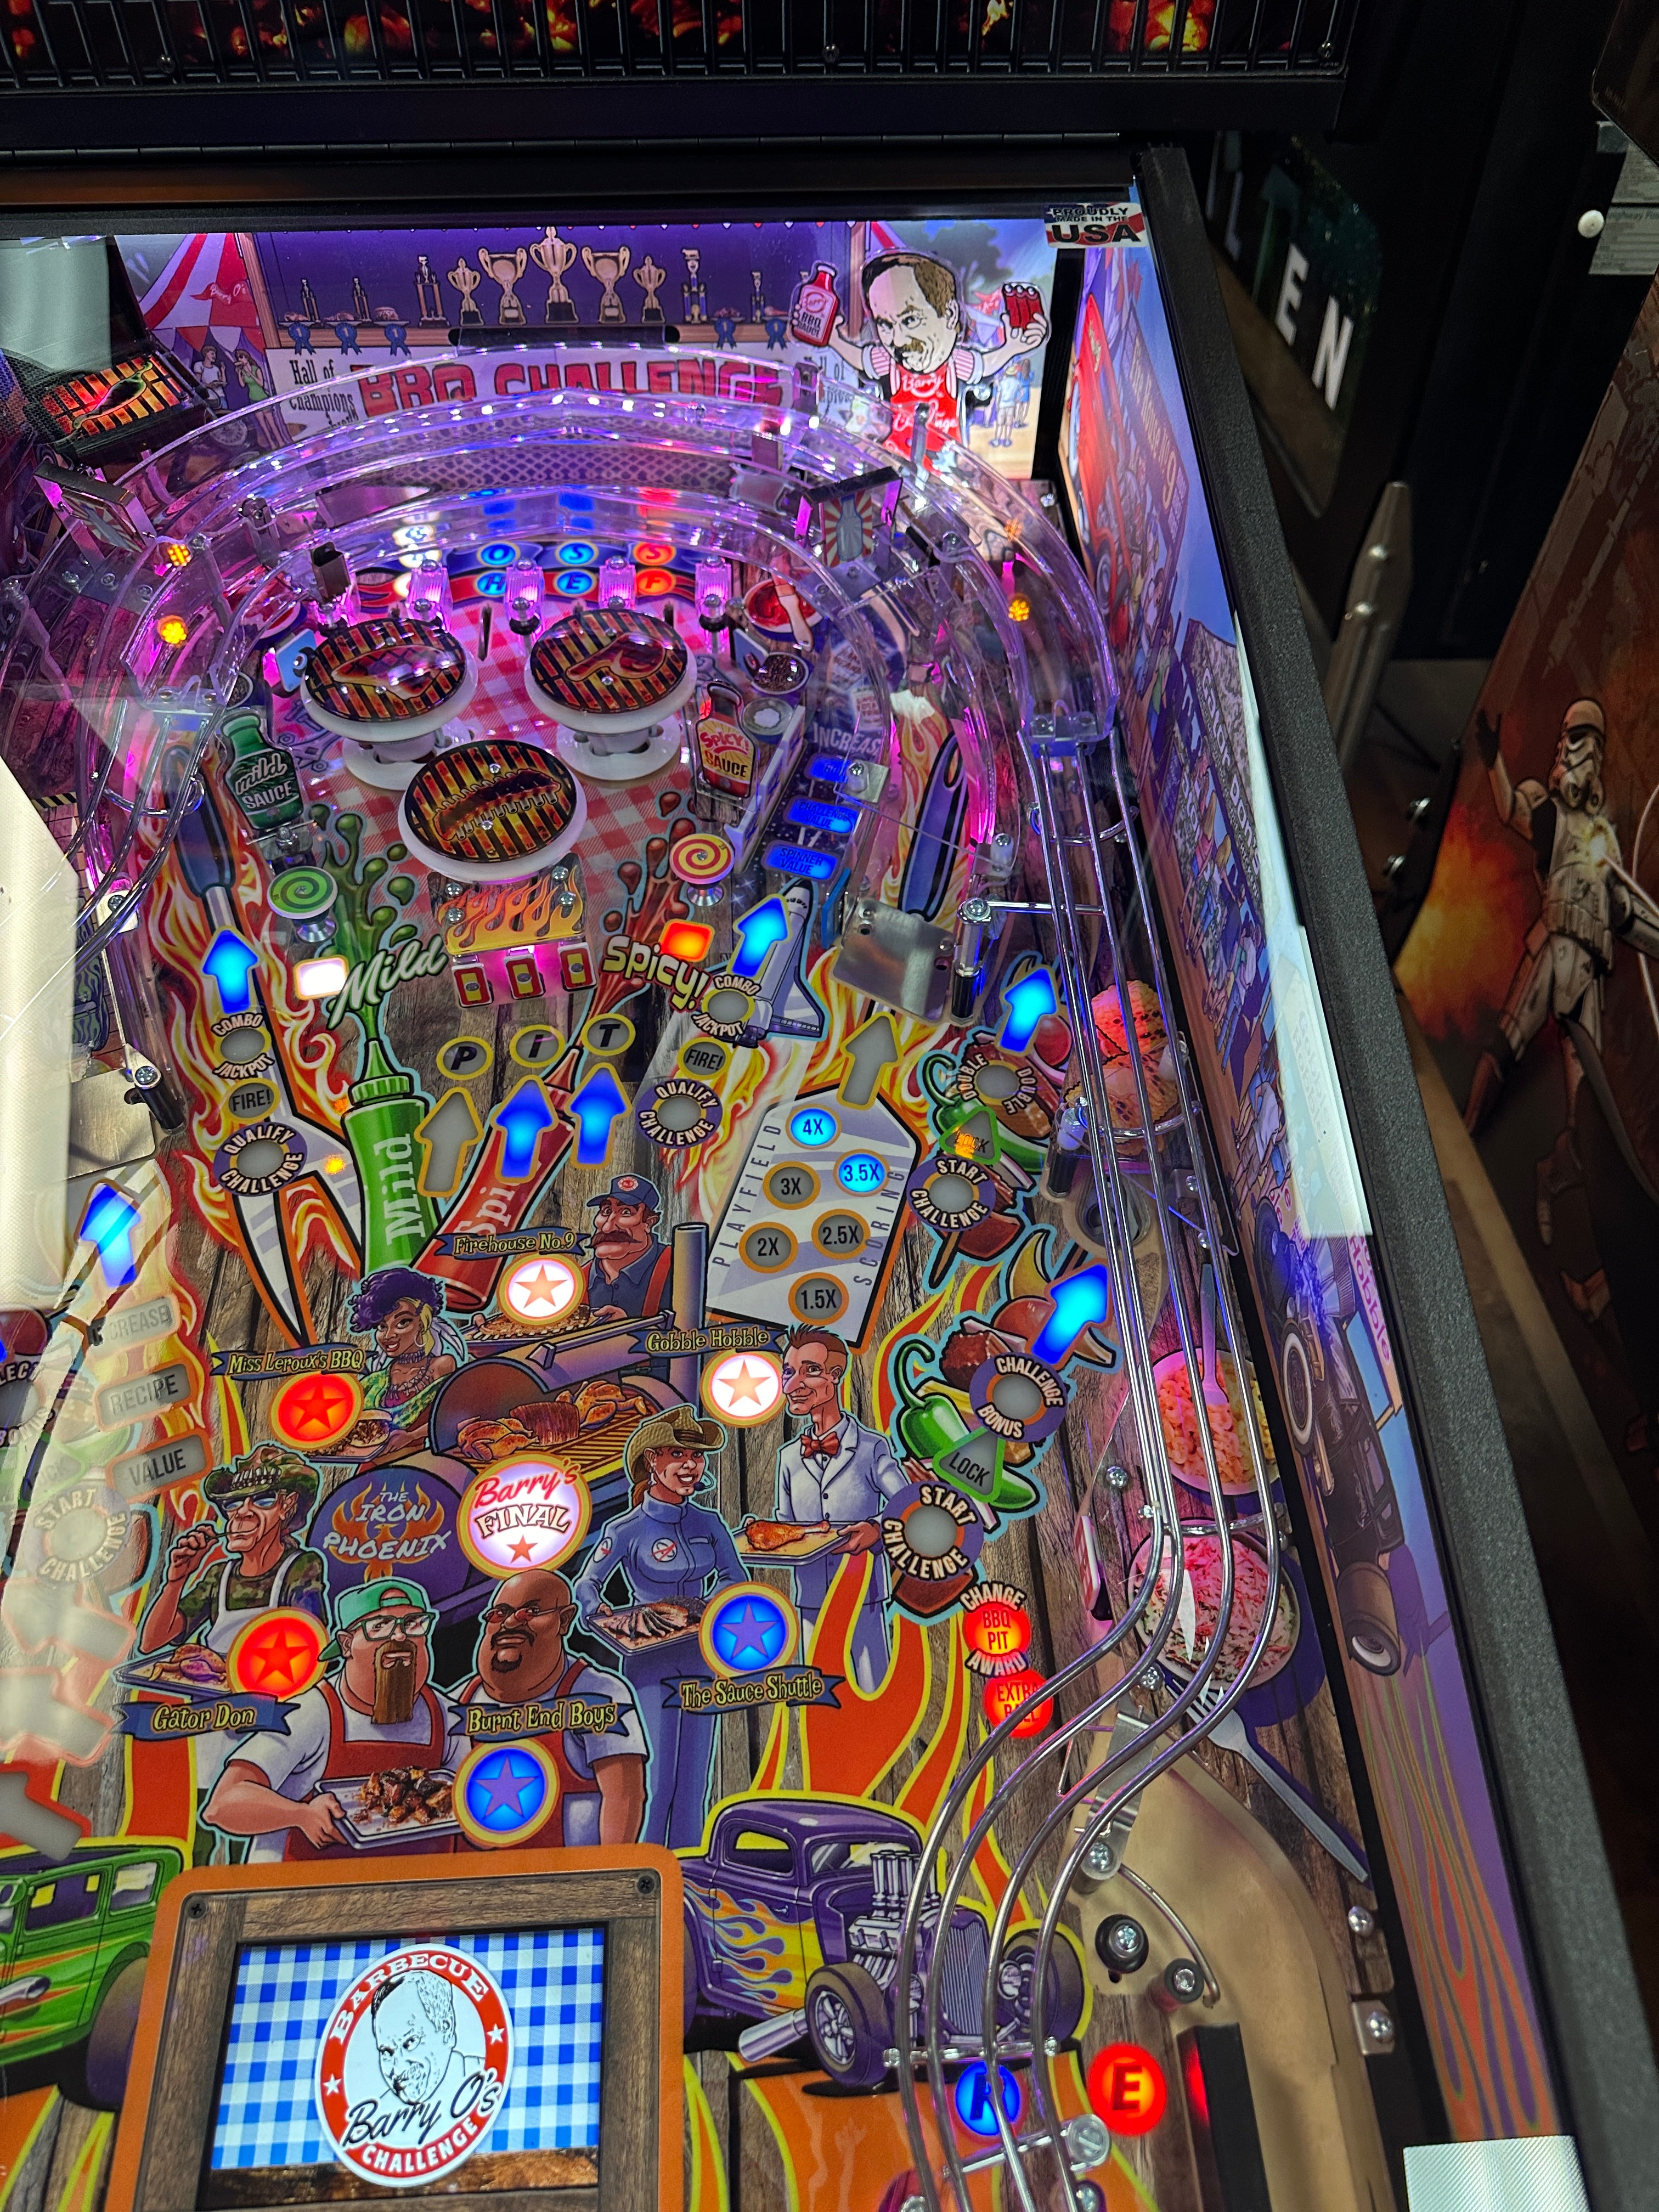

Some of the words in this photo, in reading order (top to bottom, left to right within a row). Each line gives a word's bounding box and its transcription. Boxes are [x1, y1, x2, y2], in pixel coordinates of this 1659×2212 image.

[1053, 207, 1128, 216] PROUDLY
[1052, 224, 1142, 243] USA
[289, 360, 318, 385] Hall
[324, 359, 335, 379] of
[350, 363, 477, 417] BBQ
[494, 357, 783, 407] CHALLENGE
[569, 545, 584, 560] S
[646, 545, 661, 560] S
[565, 575, 580, 590] E
[645, 576, 661, 589] F
[812, 721, 884, 758] INCREAS
[235, 753, 288, 795] mild
[704, 749, 748, 778] SAUCE
[242, 780, 292, 809] SAUCE
[805, 813, 833, 829] VALUE
[780, 847, 823, 866] SPINNER
[781, 858, 814, 875] VALUE
[326, 935, 449, 1029] Mild
[714, 975, 761, 996] COMBO
[211, 1013, 264, 1037] COMBO
[691, 1012, 746, 1037] JACKPOT
[450, 1046, 478, 1071] P
[528, 1034, 545, 1058] I
[598, 1023, 621, 1047] T
[685, 1049, 723, 1071] FIRE!
[212, 1054, 274, 1079] JACKPOT
[957, 1052, 989, 1103] DOUBLE
[232, 1089, 272, 1112] FIRE!
[656, 1081, 720, 1109] QUALIFY
[1002, 1066, 1038, 1115] DOUBLE
[223, 1124, 297, 1156] QUALIFY
[639, 1110, 715, 1146] CHALLENGE
[802, 1118, 823, 1136] 4X
[954, 1131, 990, 1153] LOCK
[221, 1152, 304, 1195] CHALLENGE
[843, 1164, 880, 1182] 3.5X
[937, 1159, 989, 1184] START
[374, 1133, 426, 1246] Mild
[712, 1125, 782, 1267] PLAYFIELD
[780, 1177, 802, 1196] 3X
[911, 1188, 988, 1229] CHALLENGE
[822, 1226, 860, 1246] 2.5X
[853, 1171, 906, 1287] SCORING
[454, 1234, 537, 1255] Firehouse
[757, 1237, 780, 1257] 2X
[800, 1289, 837, 1310] 1.5X
[1350, 1236, 1390, 1362] Hobble
[647, 1328, 707, 1352] Gobble
[709, 1327, 769, 1347] Hobble
[229, 1354, 262, 1374] Miss
[266, 1351, 328, 1372] Leroux's
[330, 1349, 364, 1369] BBQ
[110, 1374, 179, 1416] RECIPE
[996, 1356, 1063, 1407] CHALLENGE
[978, 1404, 1024, 1438] BONUS
[128, 1448, 187, 1487] VALUE
[948, 1451, 991, 1486] LOCK
[379, 1491, 409, 1503] THE
[475, 1459, 582, 1508] Barry's
[34, 1488, 97, 1530] START
[355, 1503, 426, 1522] IRON
[920, 1486, 975, 1525] START
[475, 1504, 572, 1539] FINAL
[39, 1513, 126, 1582] CHALLENGE
[323, 1530, 452, 1561] PHOENIX
[882, 1519, 968, 1579] CHALLENGE
[961, 1583, 1025, 1611] CHANGE
[982, 1610, 1011, 1628] BBQ
[988, 1631, 1008, 1650] PIT
[966, 1650, 1028, 1676] AWARD
[682, 1684, 712, 1708] The
[715, 1680, 764, 1705] Sauce
[766, 1672, 823, 1700] Shuttle
[153, 1707, 207, 1731] Gator
[213, 1703, 255, 1729] Don
[467, 1707, 521, 1733] Burnt
[527, 1704, 565, 1729] End
[570, 1701, 616, 1733] Boys
[330, 1954, 489, 2045] BARBECUE
[1111, 2063, 1143, 2112] E
[343, 2100, 441, 2146] Barry
[450, 2072, 501, 2115] O's
[360, 2116, 480, 2173] CHALLENGE
